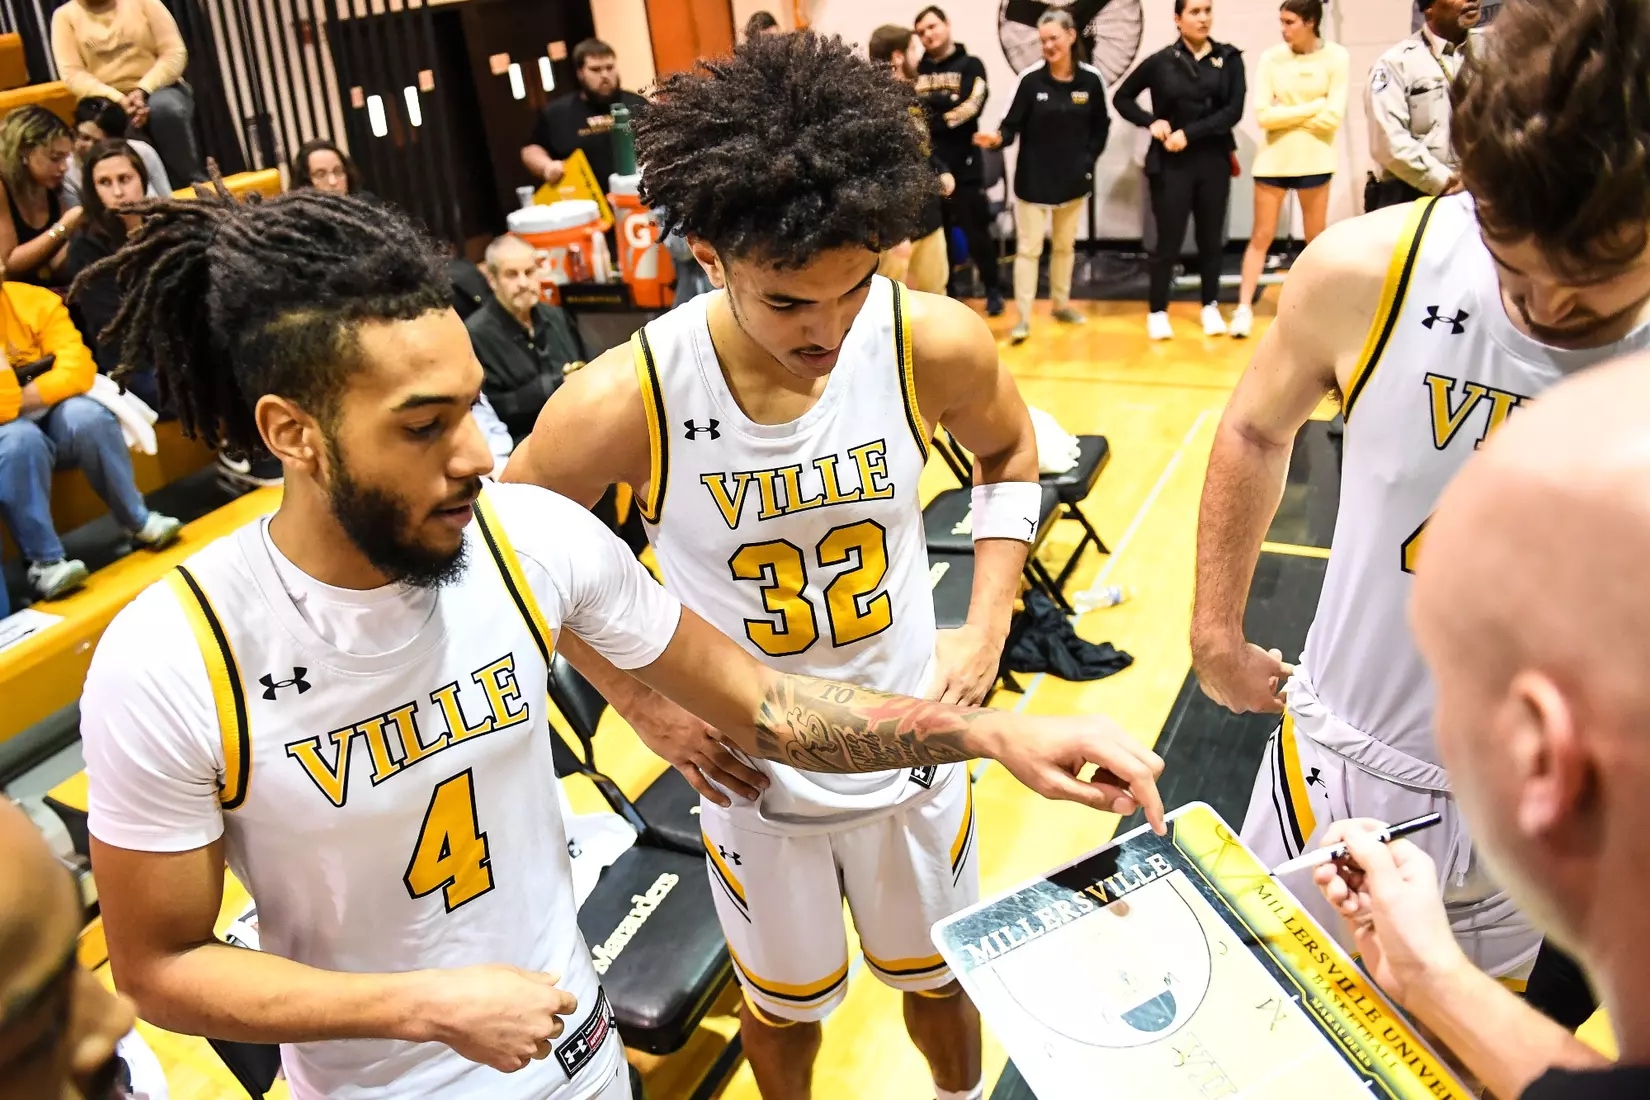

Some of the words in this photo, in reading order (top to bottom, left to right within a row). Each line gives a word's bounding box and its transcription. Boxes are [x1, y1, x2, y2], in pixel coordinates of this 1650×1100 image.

[624, 213, 651, 248] G
[1423, 372, 1532, 450] VI
[700, 438, 894, 530] VILLE
[728, 518, 893, 657] 32
[284, 652, 529, 808] VILLE
[403, 767, 495, 914] 4
[961, 852, 1173, 966] MILLERSVILLE
[1253, 884, 1382, 1023] MILLERSVILLE
[1311, 974, 1397, 1069] BASKETBALL
